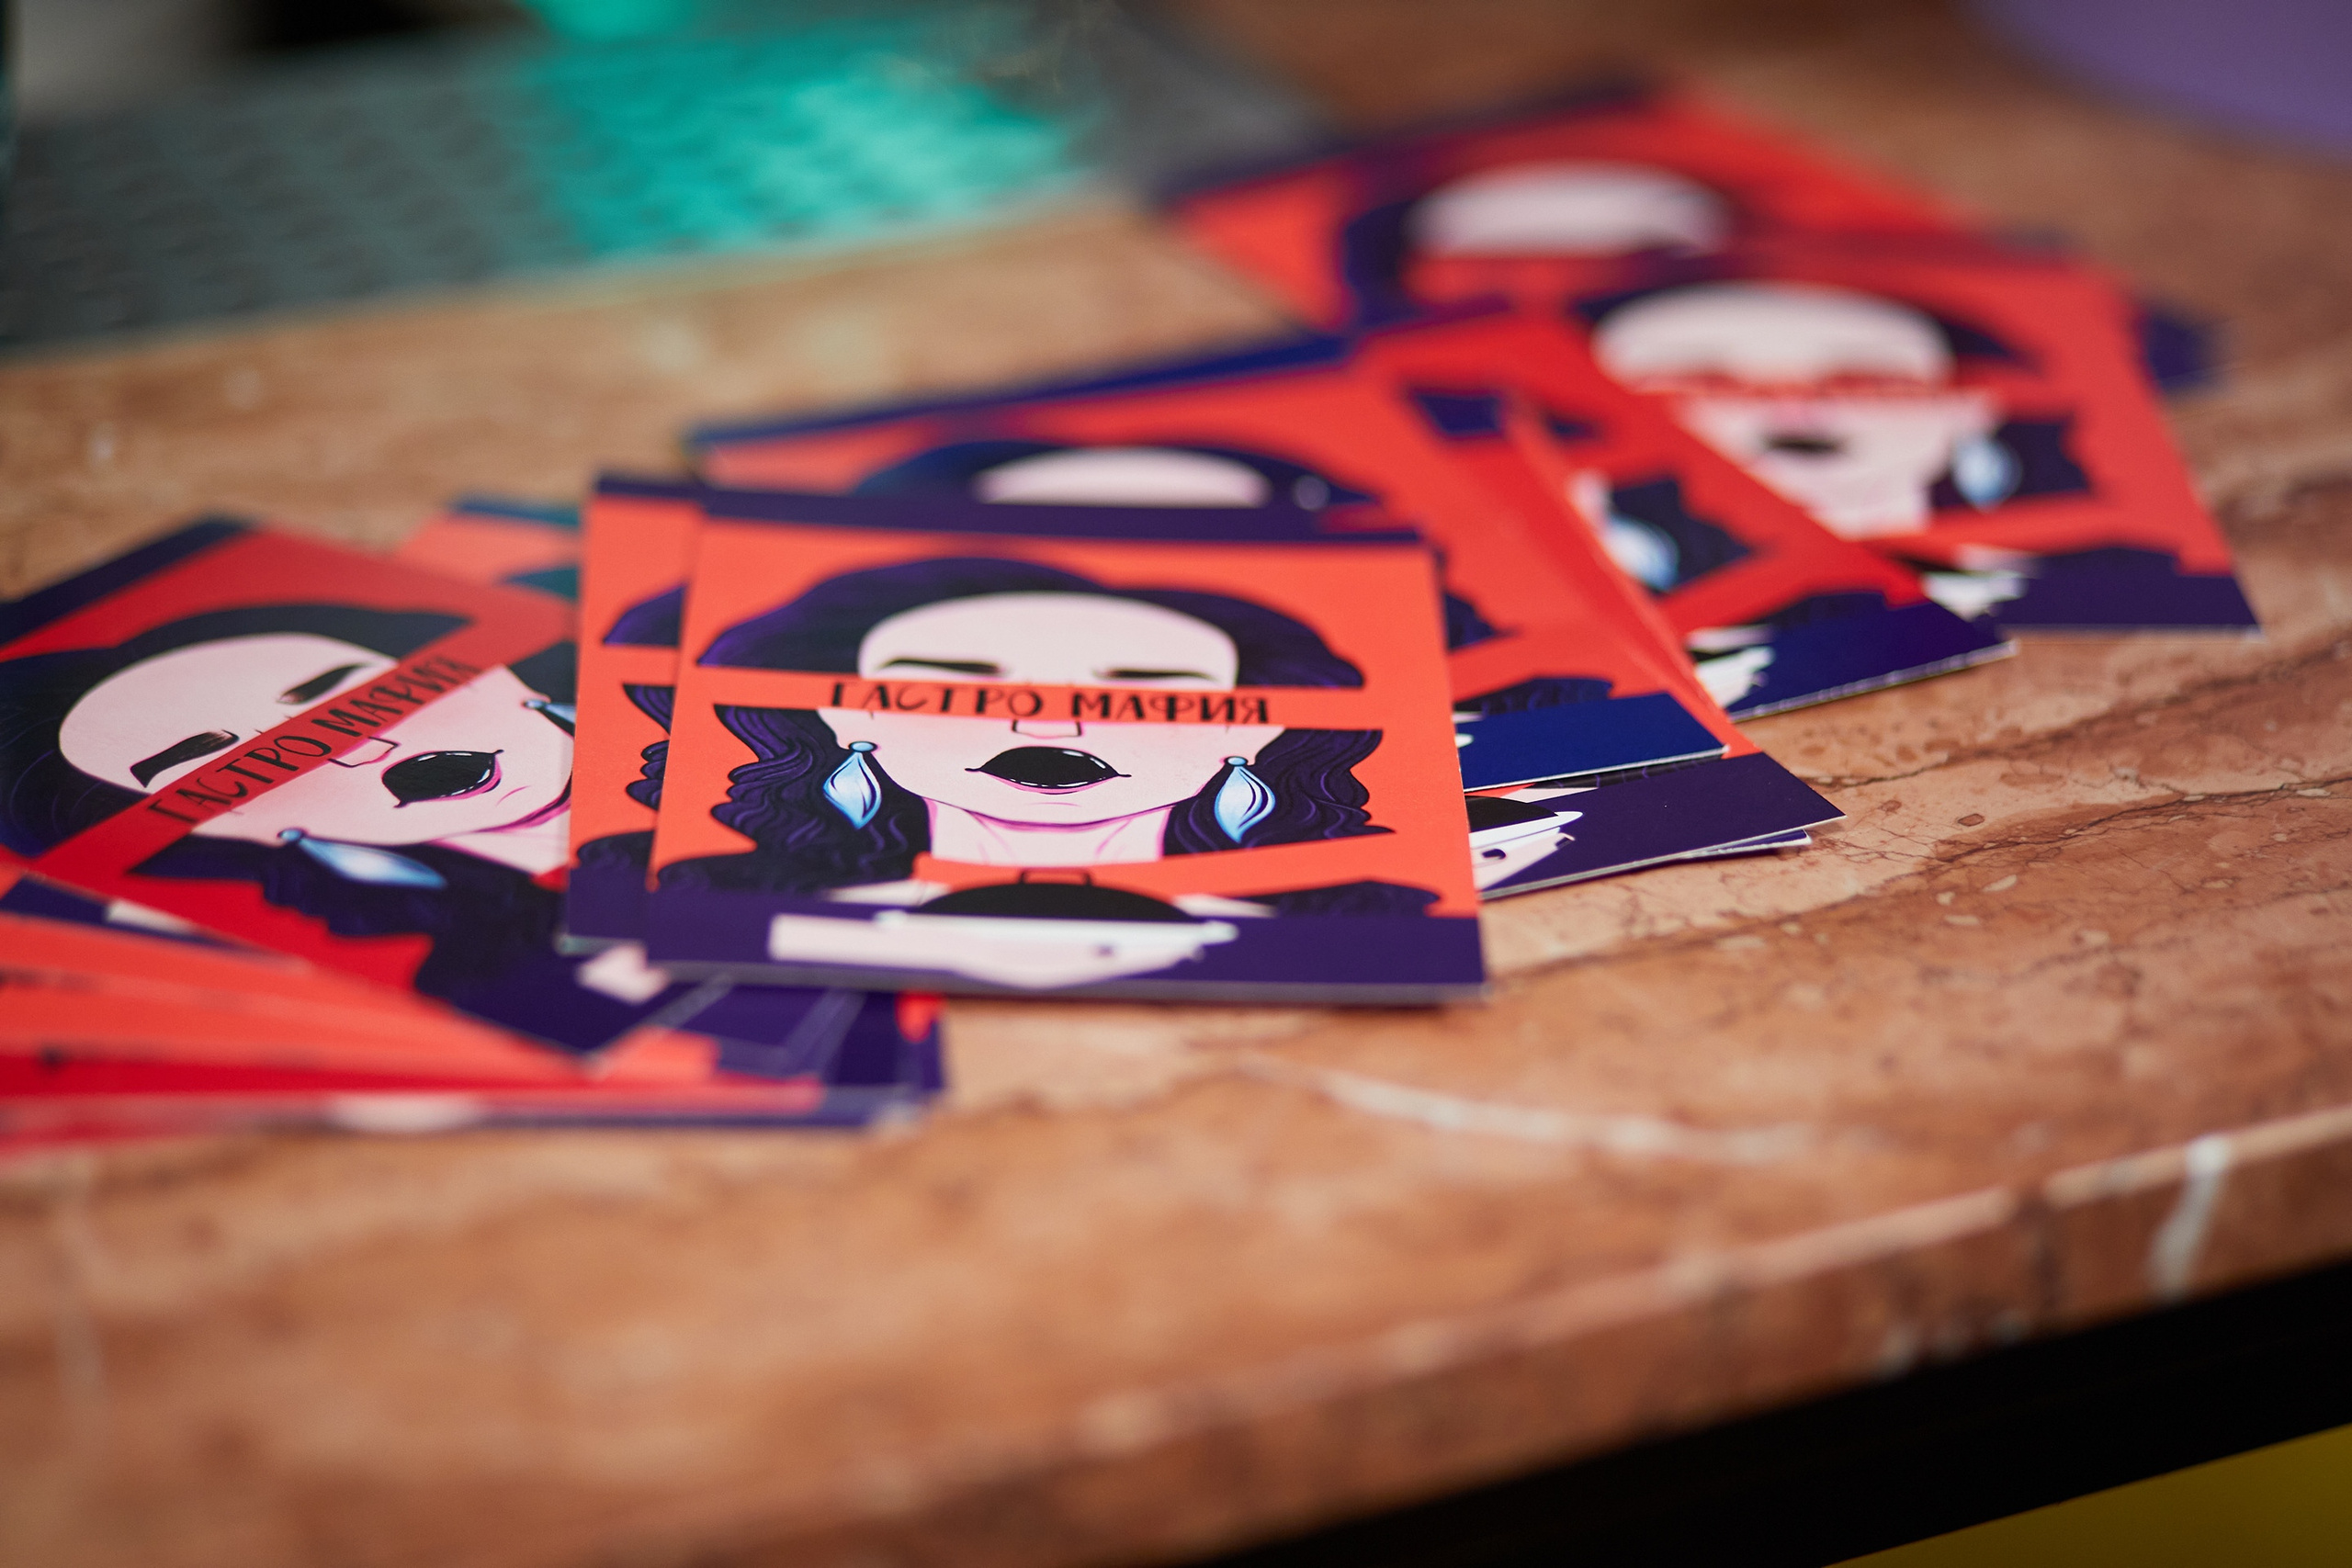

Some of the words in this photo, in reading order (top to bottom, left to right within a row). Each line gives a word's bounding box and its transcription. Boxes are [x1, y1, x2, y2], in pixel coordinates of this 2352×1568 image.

[831, 682, 1044, 717] ГАСТРО
[1071, 692, 1269, 725] МАФИЯ
[147, 735, 333, 824] ГАСТРО
